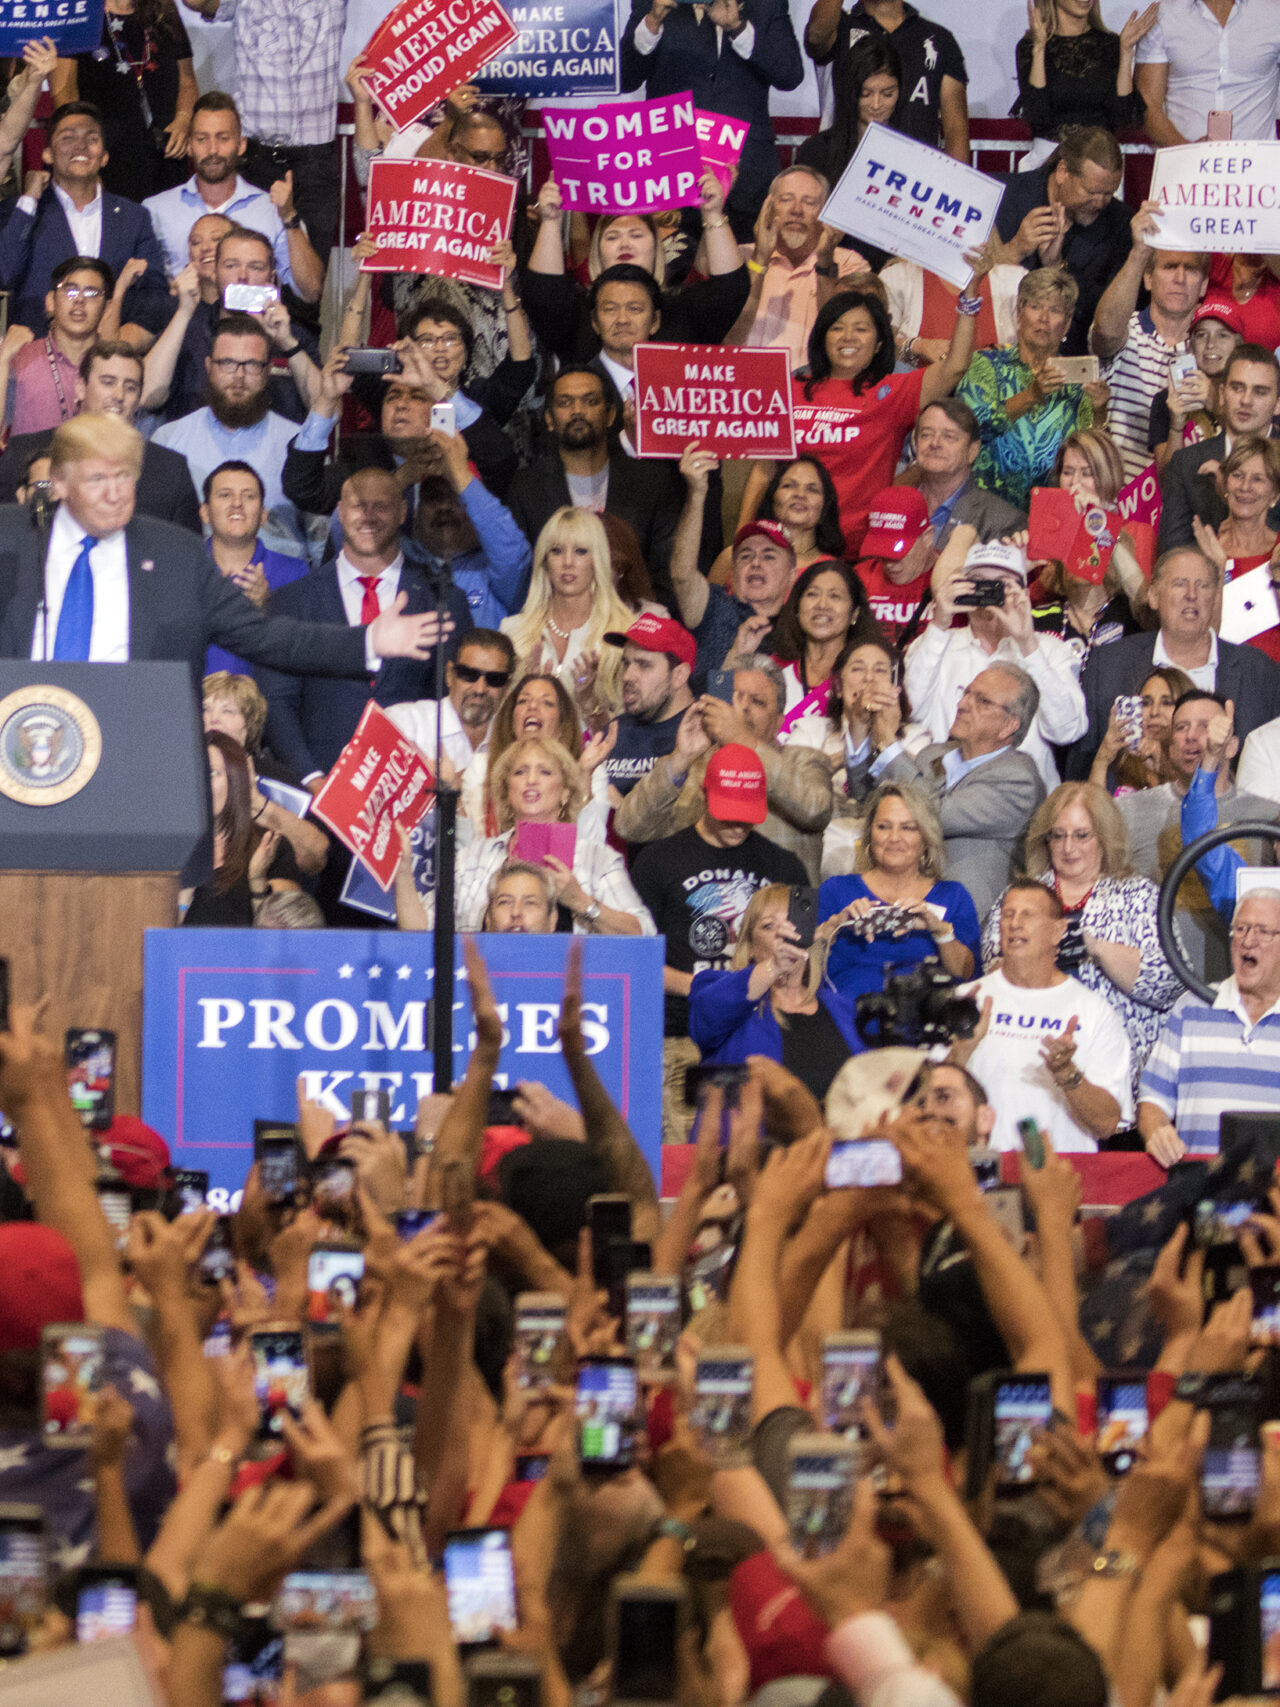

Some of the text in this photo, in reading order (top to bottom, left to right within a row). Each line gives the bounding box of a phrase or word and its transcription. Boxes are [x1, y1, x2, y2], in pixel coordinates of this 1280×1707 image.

[391, 0, 437, 37] MAKE
[512, 6, 565, 23] MAKE
[510, 27, 614, 54] ERICA
[384, 10, 502, 110] PROUD AGAIN
[552, 57, 614, 76] AGAIN
[545, 101, 695, 141] WOMEN
[597, 149, 652, 171] FOR
[1200, 158, 1252, 174] KEEP
[413, 178, 466, 200] MAKE
[562, 172, 695, 206] TRUMP
[867, 160, 982, 224] TRUMP
[370, 200, 502, 243] AMERICA
[865, 185, 968, 238] PENCE
[1190, 217, 1257, 235] GREAT
[376, 232, 493, 262] GREAT AGAIN
[684, 364, 735, 382] MAKE
[641, 386, 789, 415] AMERICA
[652, 418, 779, 438] GREAT AGAIN
[793, 410, 814, 420] SIAN
[794, 427, 860, 444] RUMP
[869, 602, 934, 622] TRU
[350, 746, 381, 791] MAKE
[392, 766, 428, 819] AGAIN
